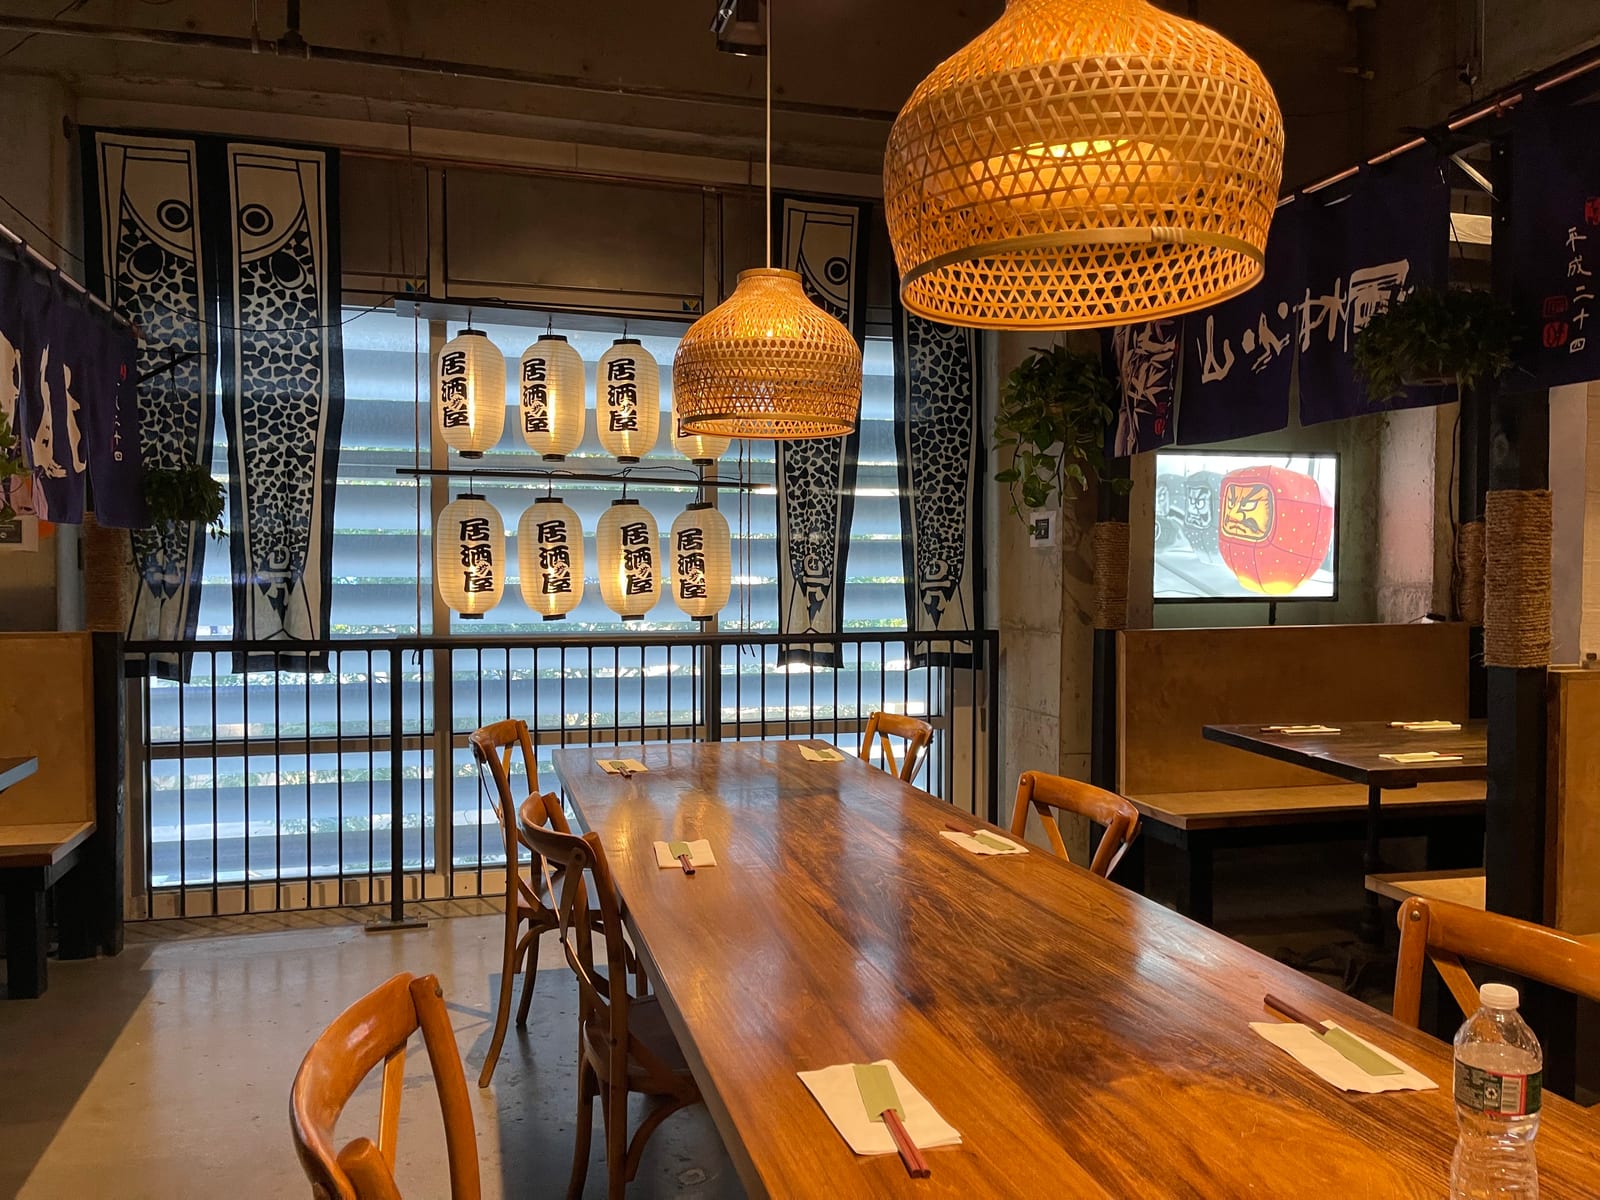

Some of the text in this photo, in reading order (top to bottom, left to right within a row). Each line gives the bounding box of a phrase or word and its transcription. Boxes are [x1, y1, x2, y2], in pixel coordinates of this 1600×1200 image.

[1565, 226, 1595, 354] 平成二十四
[441, 351, 470, 428] 居酒屋
[522, 358, 550, 433] 居酒屋
[607, 358, 639, 432] 居酒屋
[459, 518, 494, 593] 居酒屋
[536, 520, 572, 595] 居酒屋
[620, 522, 654, 596] 居酒屋
[676, 528, 708, 600] 居酒屋
